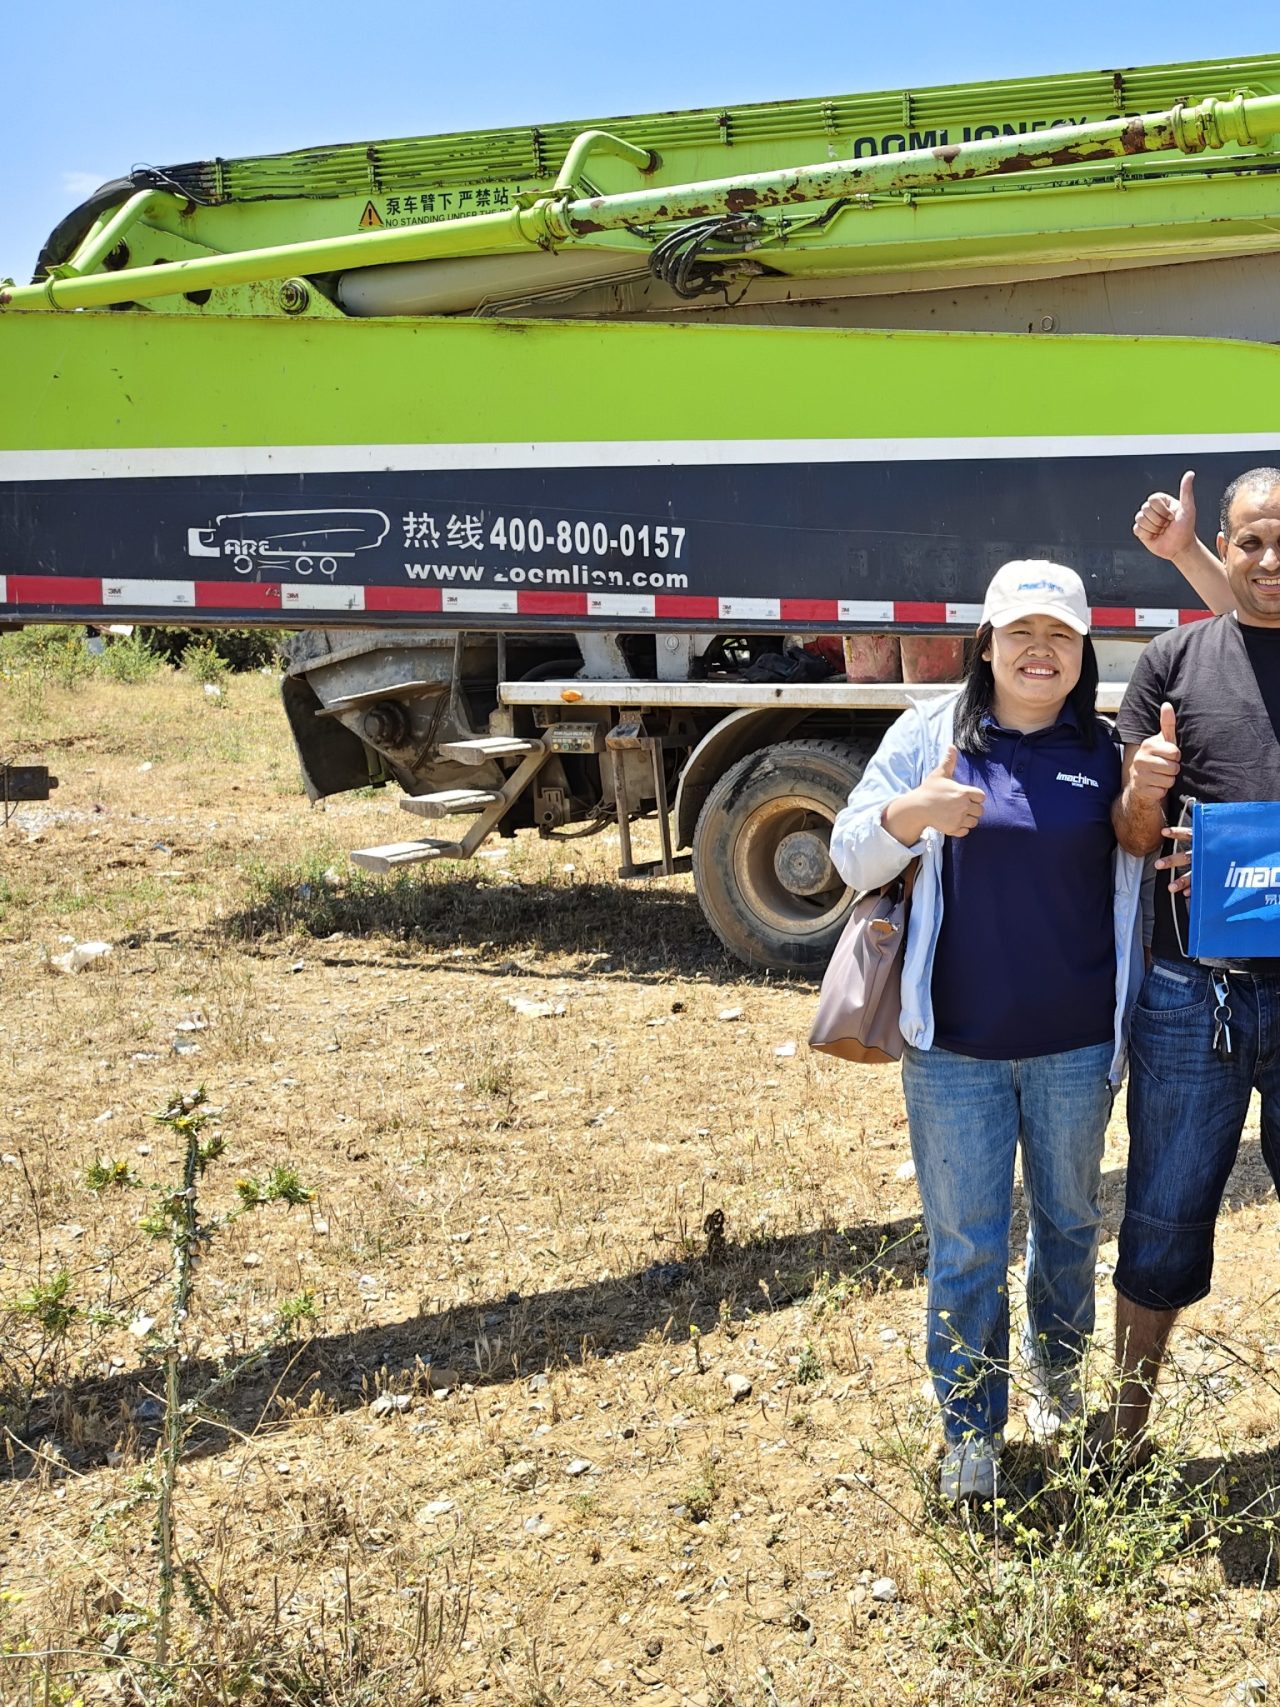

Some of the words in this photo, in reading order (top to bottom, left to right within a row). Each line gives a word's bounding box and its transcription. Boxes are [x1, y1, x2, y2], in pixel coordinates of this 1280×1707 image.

[386, 186, 522, 216] 泵车臂下严禁站
[385, 219, 399, 227] NO
[400, 214, 446, 226] STANDING
[402, 511, 485, 551] 热线
[489, 516, 686, 559] 400-800-0157
